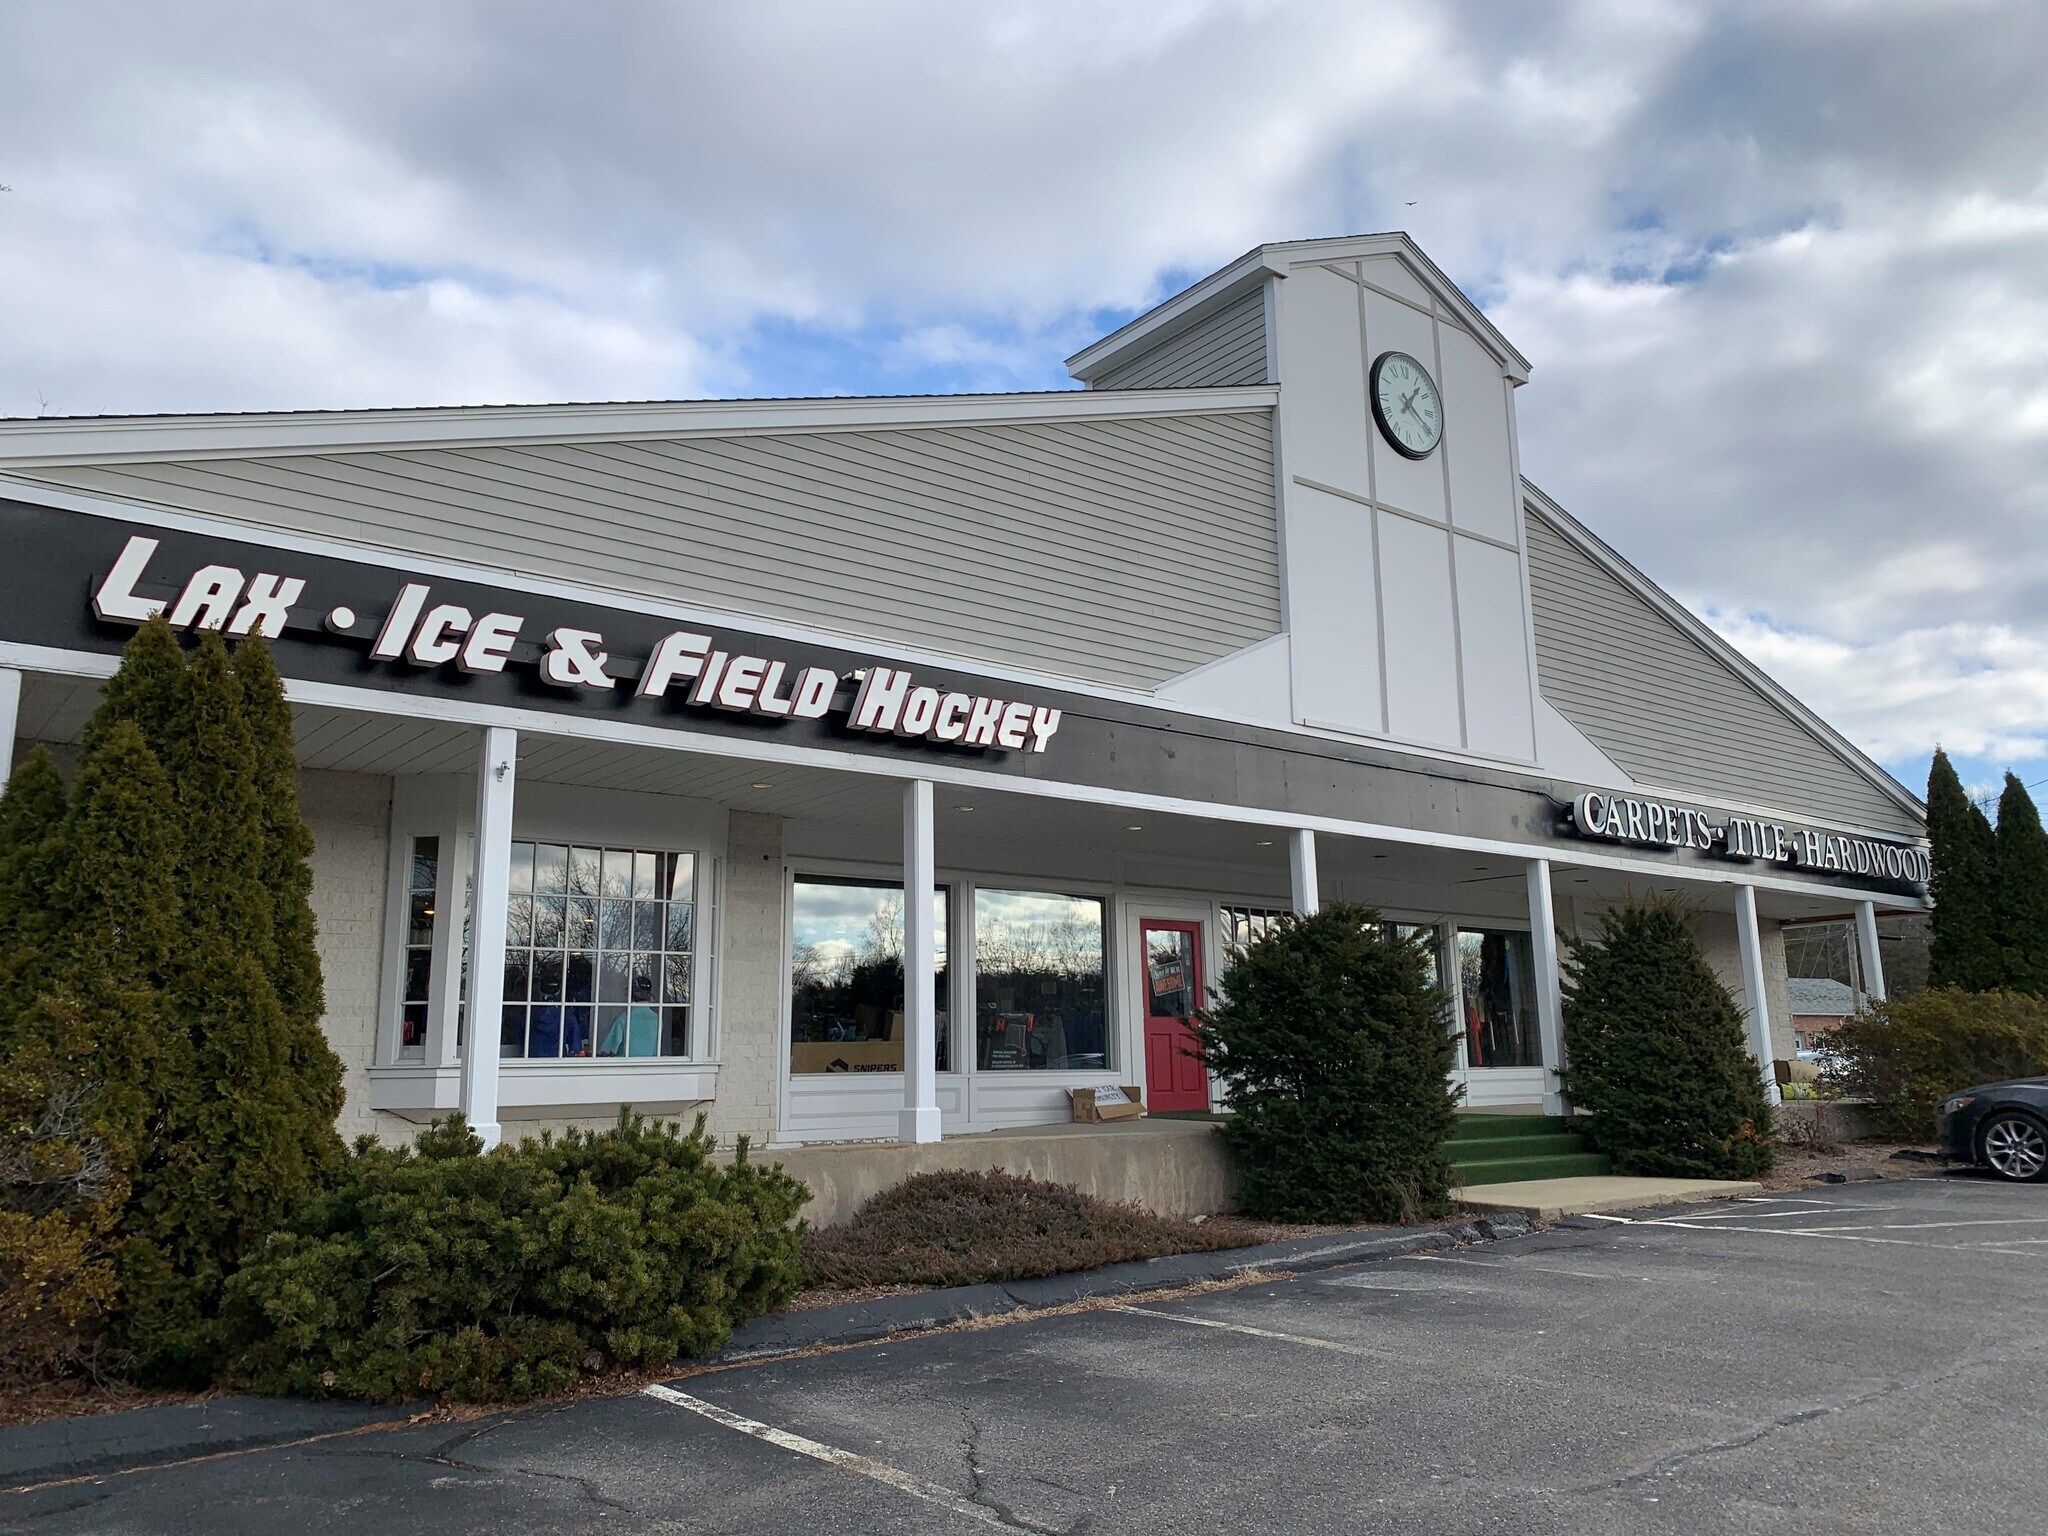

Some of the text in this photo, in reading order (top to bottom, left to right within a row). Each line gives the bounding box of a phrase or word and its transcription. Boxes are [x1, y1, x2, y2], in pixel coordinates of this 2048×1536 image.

[96, 536, 1062, 753] LAX ICE & FIELD HOCKEY
[1579, 792, 1931, 882] CARPETS TILE HARDWOOD
[853, 1063, 897, 1072] SNIPERS
